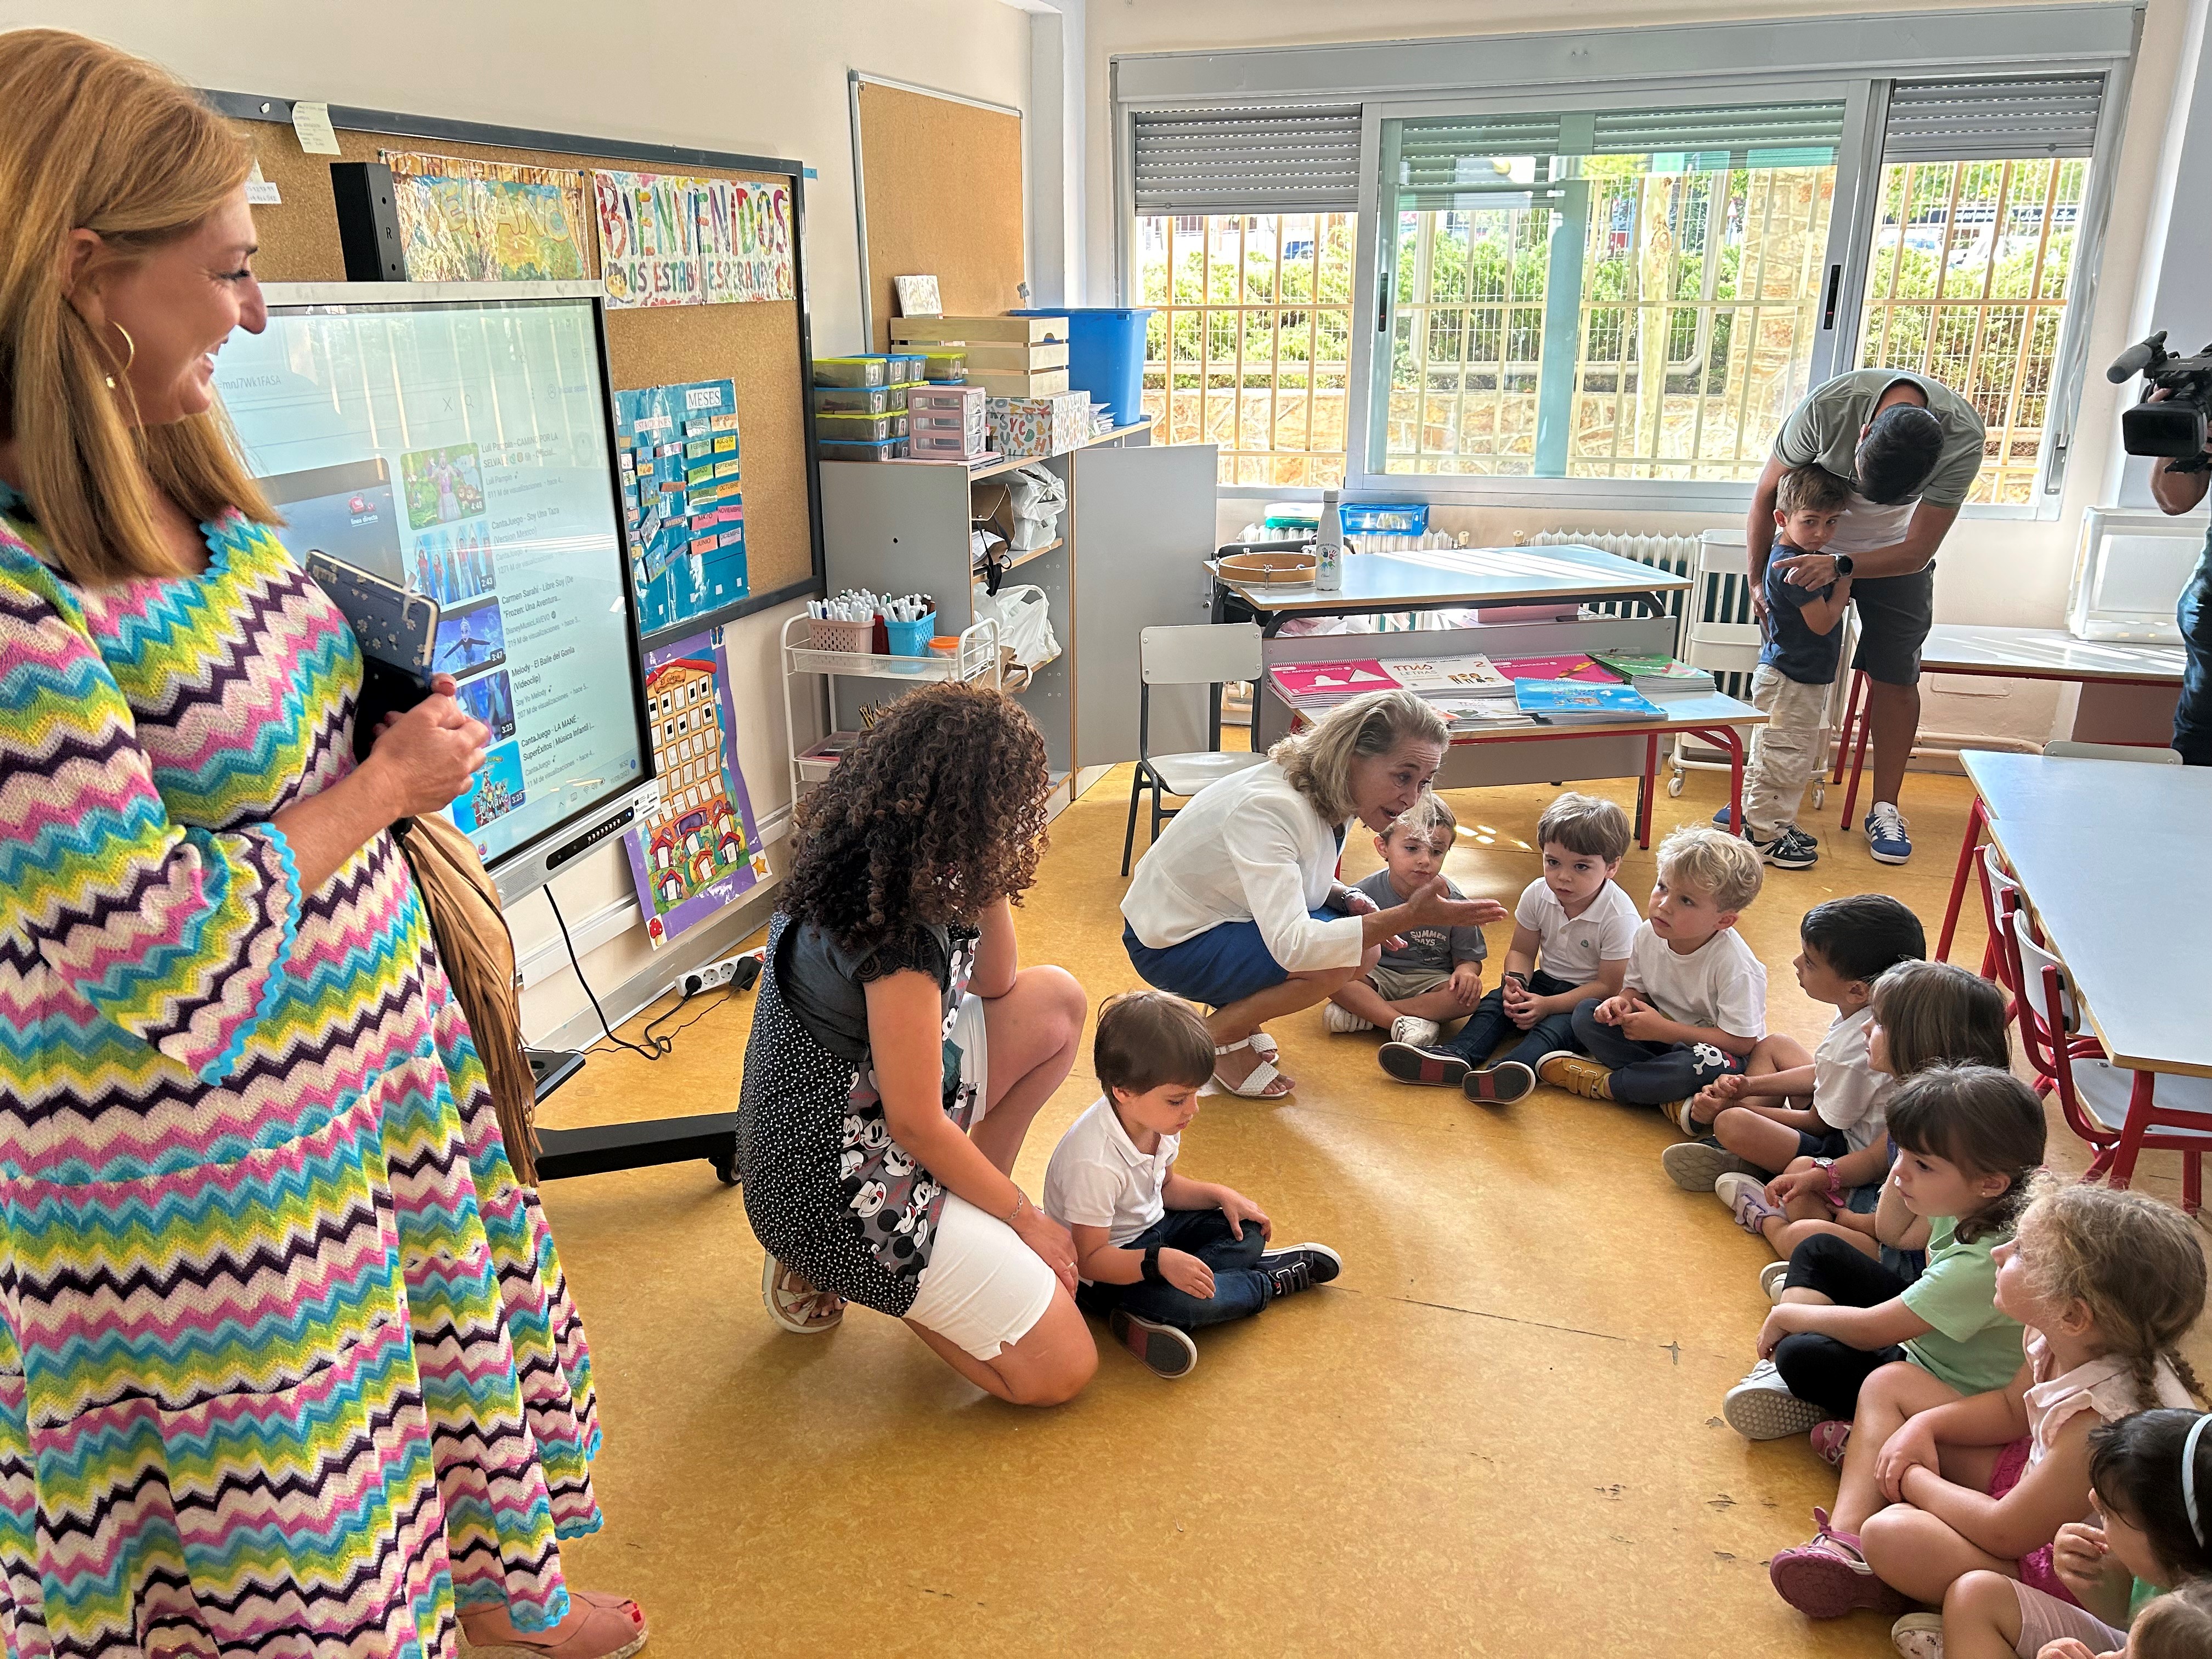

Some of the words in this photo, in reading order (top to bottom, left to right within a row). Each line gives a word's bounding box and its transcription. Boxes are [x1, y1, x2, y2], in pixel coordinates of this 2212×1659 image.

[596, 173, 788, 259] BIENVENIDOS
[386, 227, 392, 239] R
[629, 262, 647, 293] OS
[688, 391, 720, 408] MESES
[693, 466, 708, 475] MARZO
[715, 460, 738, 470] SEPTIEMBRE
[719, 482, 739, 491] OCTUBRE
[527, 512, 537, 522] Soy
[720, 528, 740, 540] DICIEMBRE
[697, 538, 711, 546] JUNIO
[501, 592, 522, 605] Carmen
[542, 582, 555, 591] Libre
[555, 579, 565, 587] Soy
[524, 602, 535, 612] Una
[511, 663, 531, 678] Melody
[534, 659, 539, 668] El
[540, 654, 552, 666] Baile
[514, 673, 541, 693] (Videoclip)
[516, 698, 524, 707] Soy
[501, 723, 514, 733] 3:23
[521, 729, 551, 747] CantaJuego
[554, 723, 562, 732] LA
[562, 714, 577, 729] MANÉ
[523, 742, 552, 761] SuperÉxitos
[573, 724, 589, 737] Infantil
[525, 760, 551, 776] CantaJuego
[511, 793, 523, 804] 3:23
[1410, 930, 1447, 941] SUMMER
